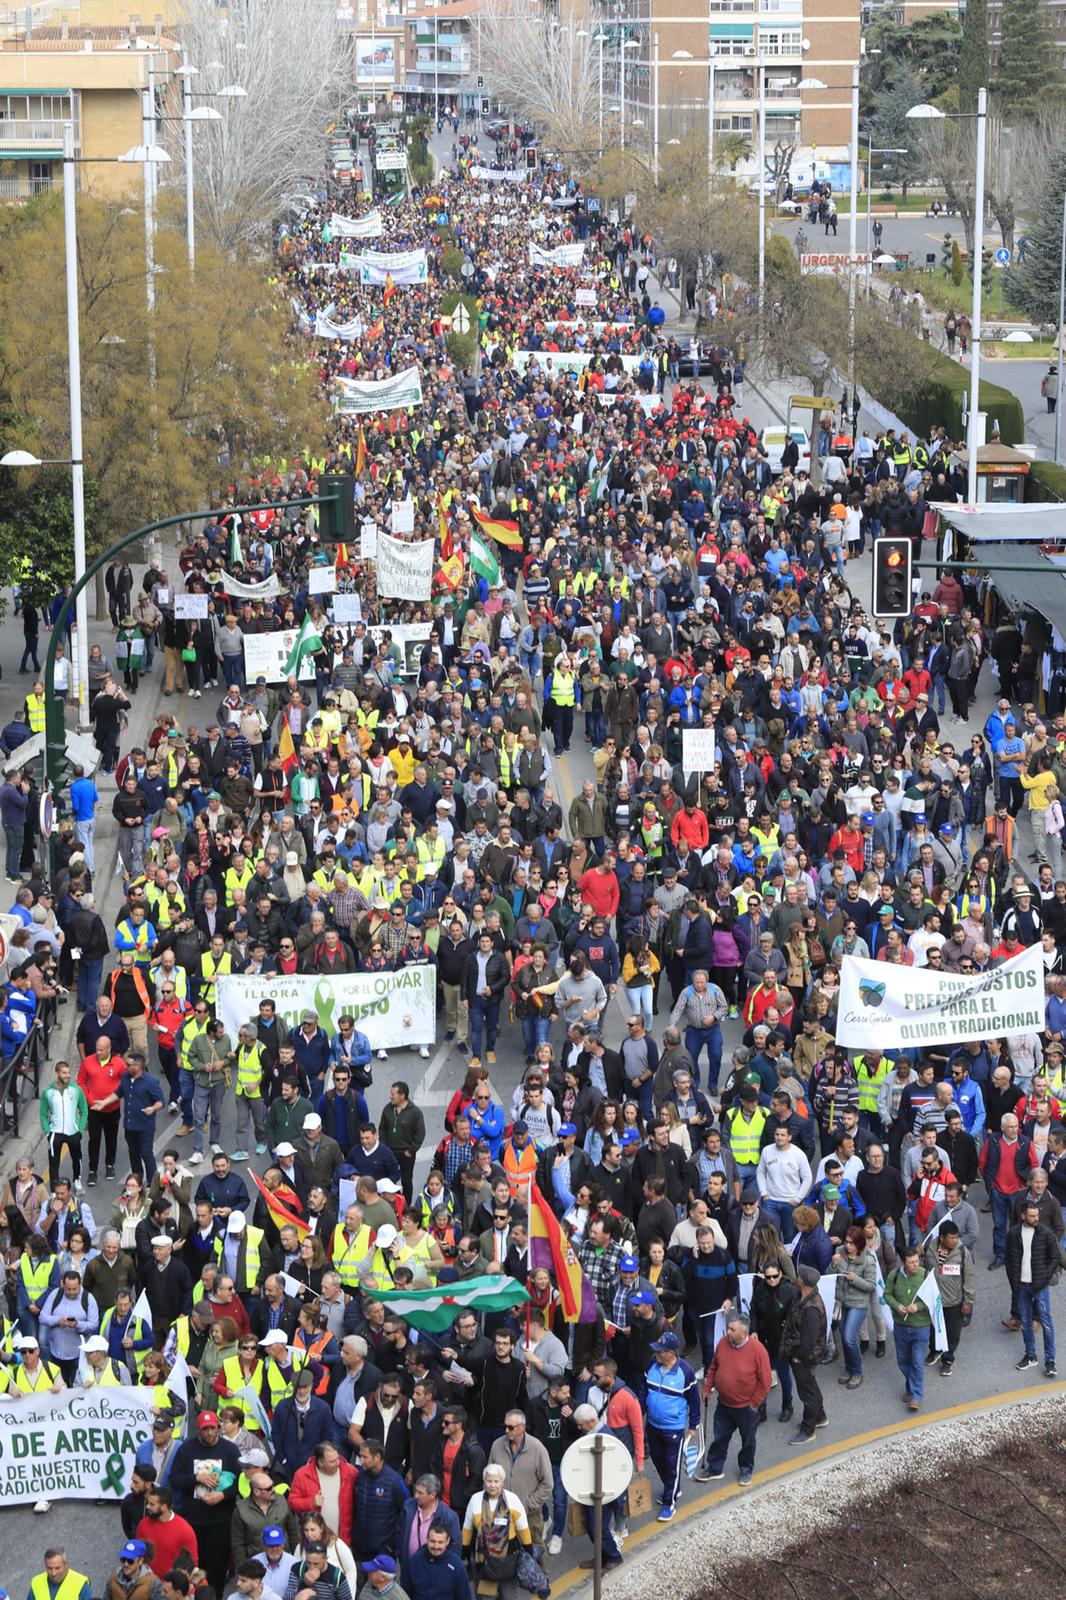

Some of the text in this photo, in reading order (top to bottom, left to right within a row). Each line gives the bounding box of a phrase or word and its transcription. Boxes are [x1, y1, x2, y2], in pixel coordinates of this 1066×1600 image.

[802, 255, 868, 267] URGENCAS
[940, 997, 997, 1017] PARA EL
[900, 1011, 1041, 1039] OLIVAR TRADICIONAL
[11, 1431, 47, 1459] DE
[6, 1458, 100, 1481] DE NUESTRO
